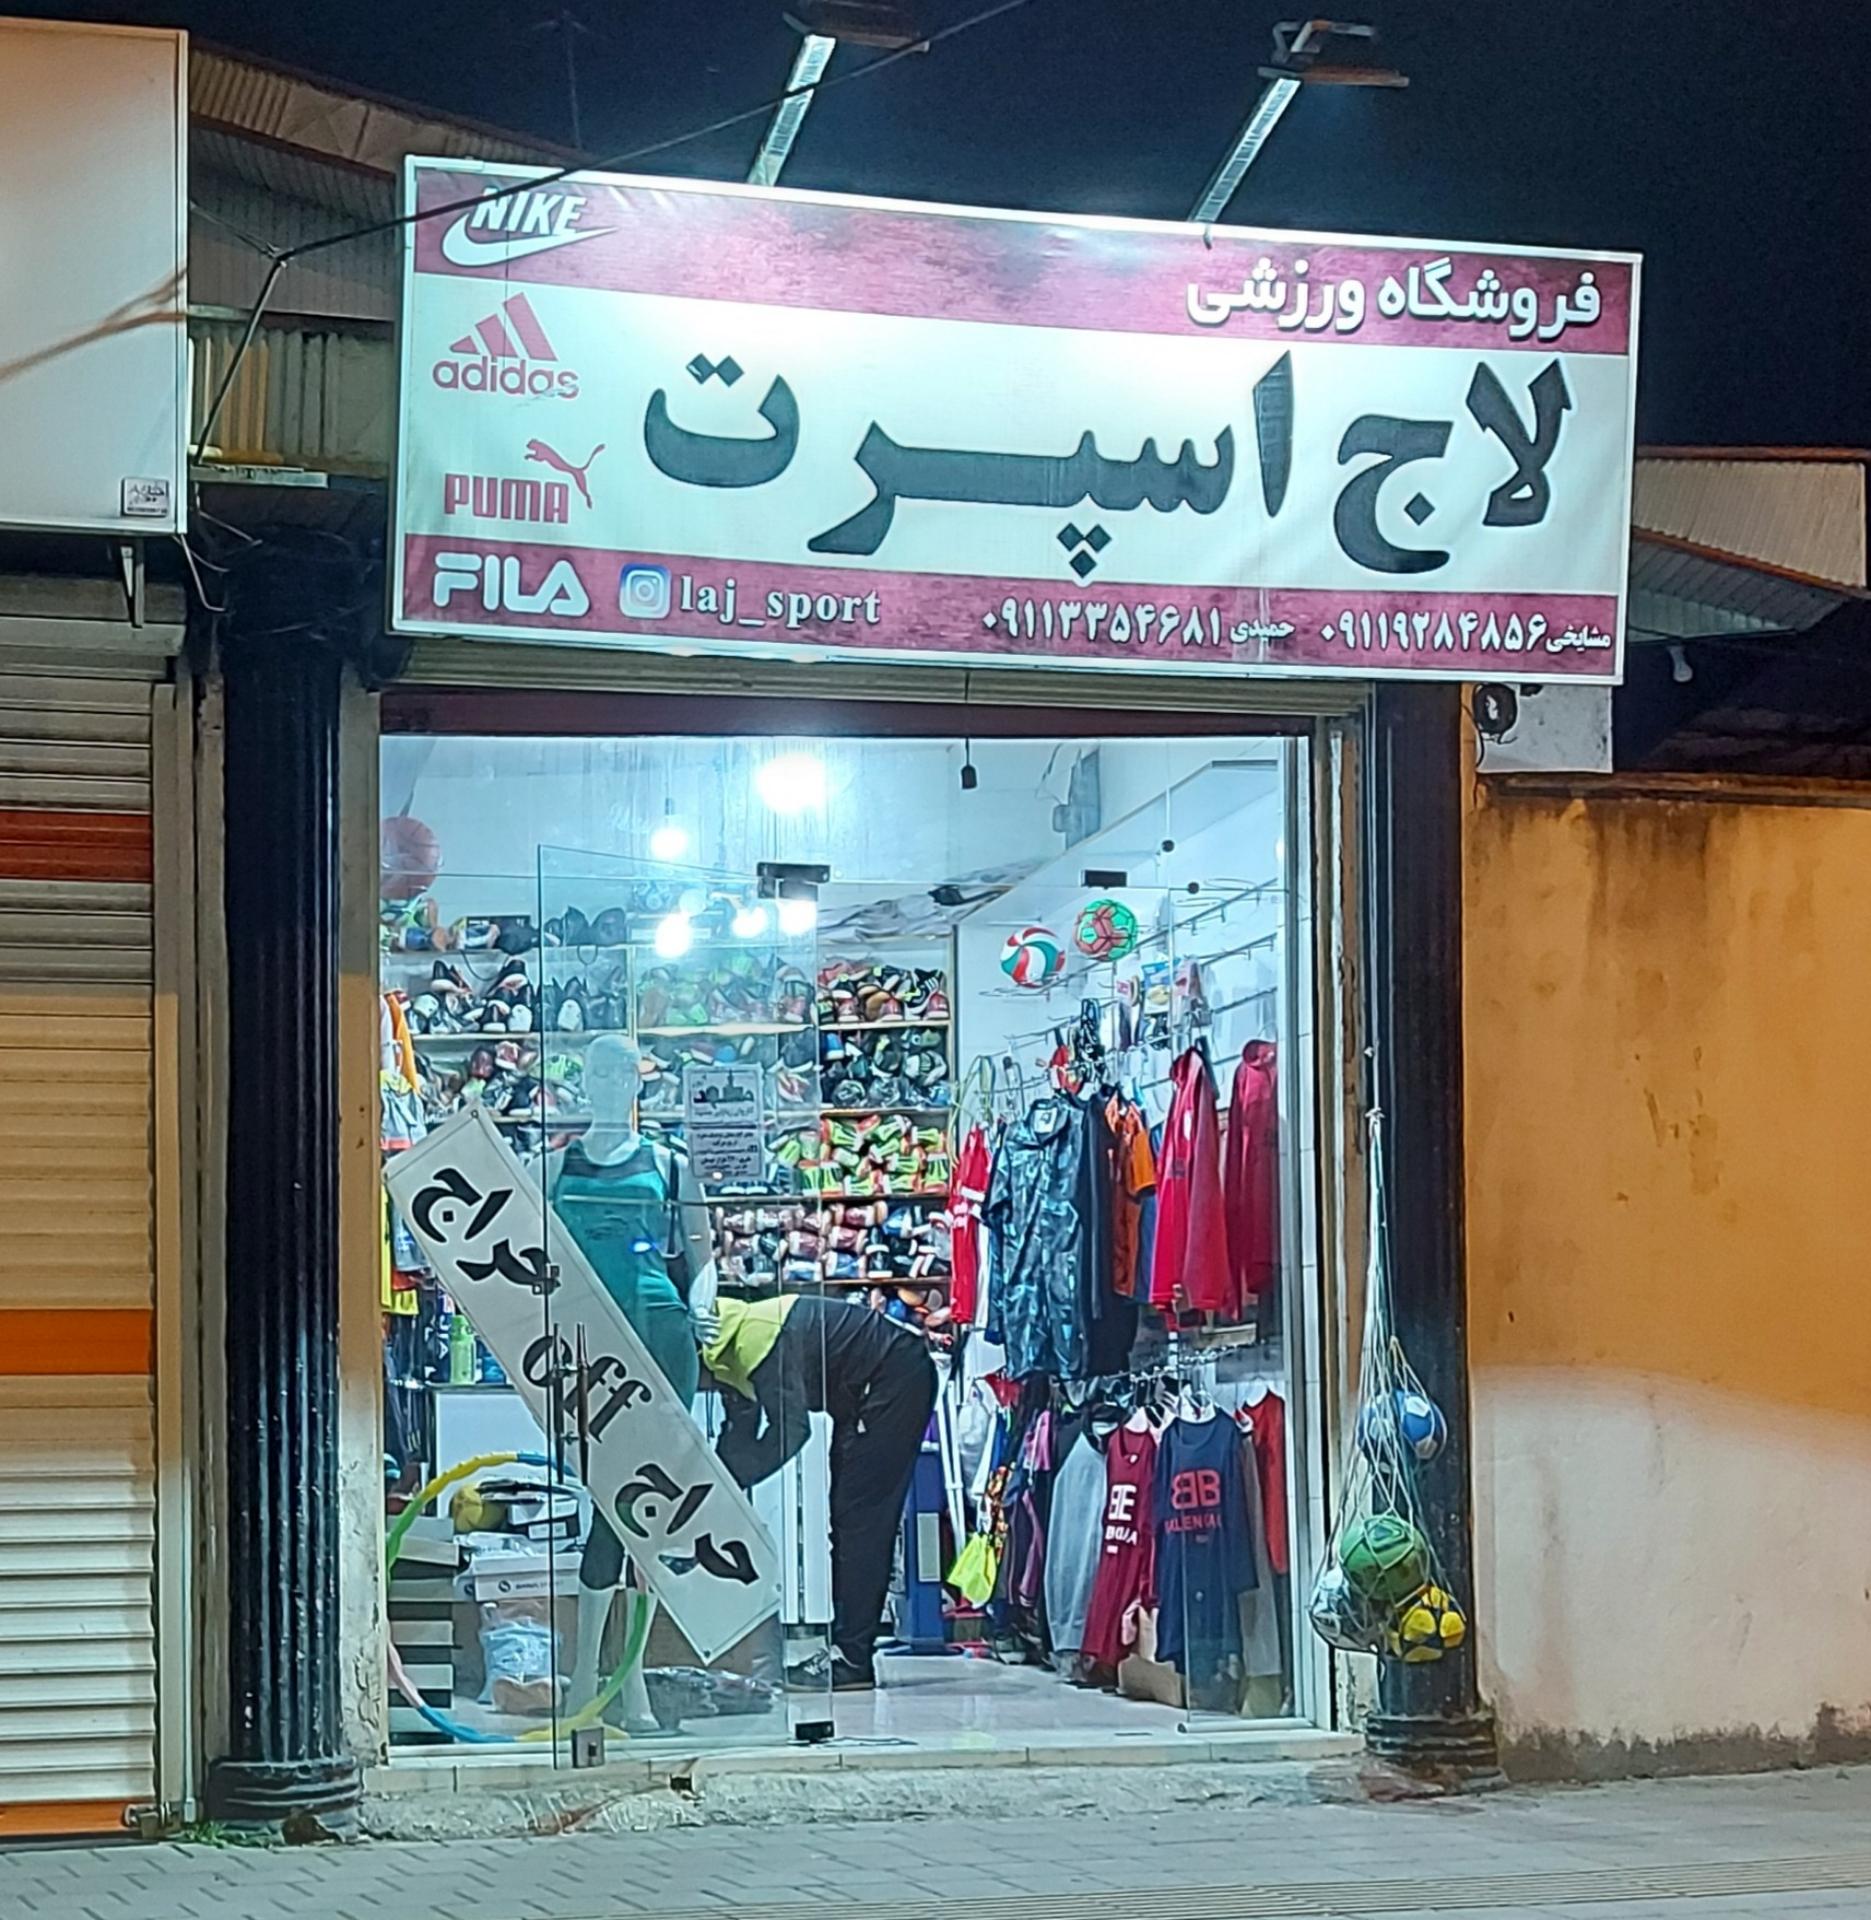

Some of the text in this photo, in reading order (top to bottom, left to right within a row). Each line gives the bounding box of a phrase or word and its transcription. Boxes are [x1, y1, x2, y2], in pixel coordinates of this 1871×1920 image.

[471, 188, 587, 236] NIKE
[1187, 256, 1601, 340] فروشگاه ورزشی
[431, 356, 581, 400] adidas
[644, 349, 1573, 580] لاج اسپرت
[443, 472, 570, 525] PUMA
[432, 551, 591, 617] FILA
[679, 574, 881, 629] laj_sport
[982, 596, 1297, 646] حمیدی ۰۹۱۱۳۳۵۴۶۸۱
[1320, 609, 1613, 653] مشایخی ۰۹۱۱۹۲۸۴۸۵۶
[411, 1167, 558, 1288] حراج
[615, 1463, 760, 1586] حراج
